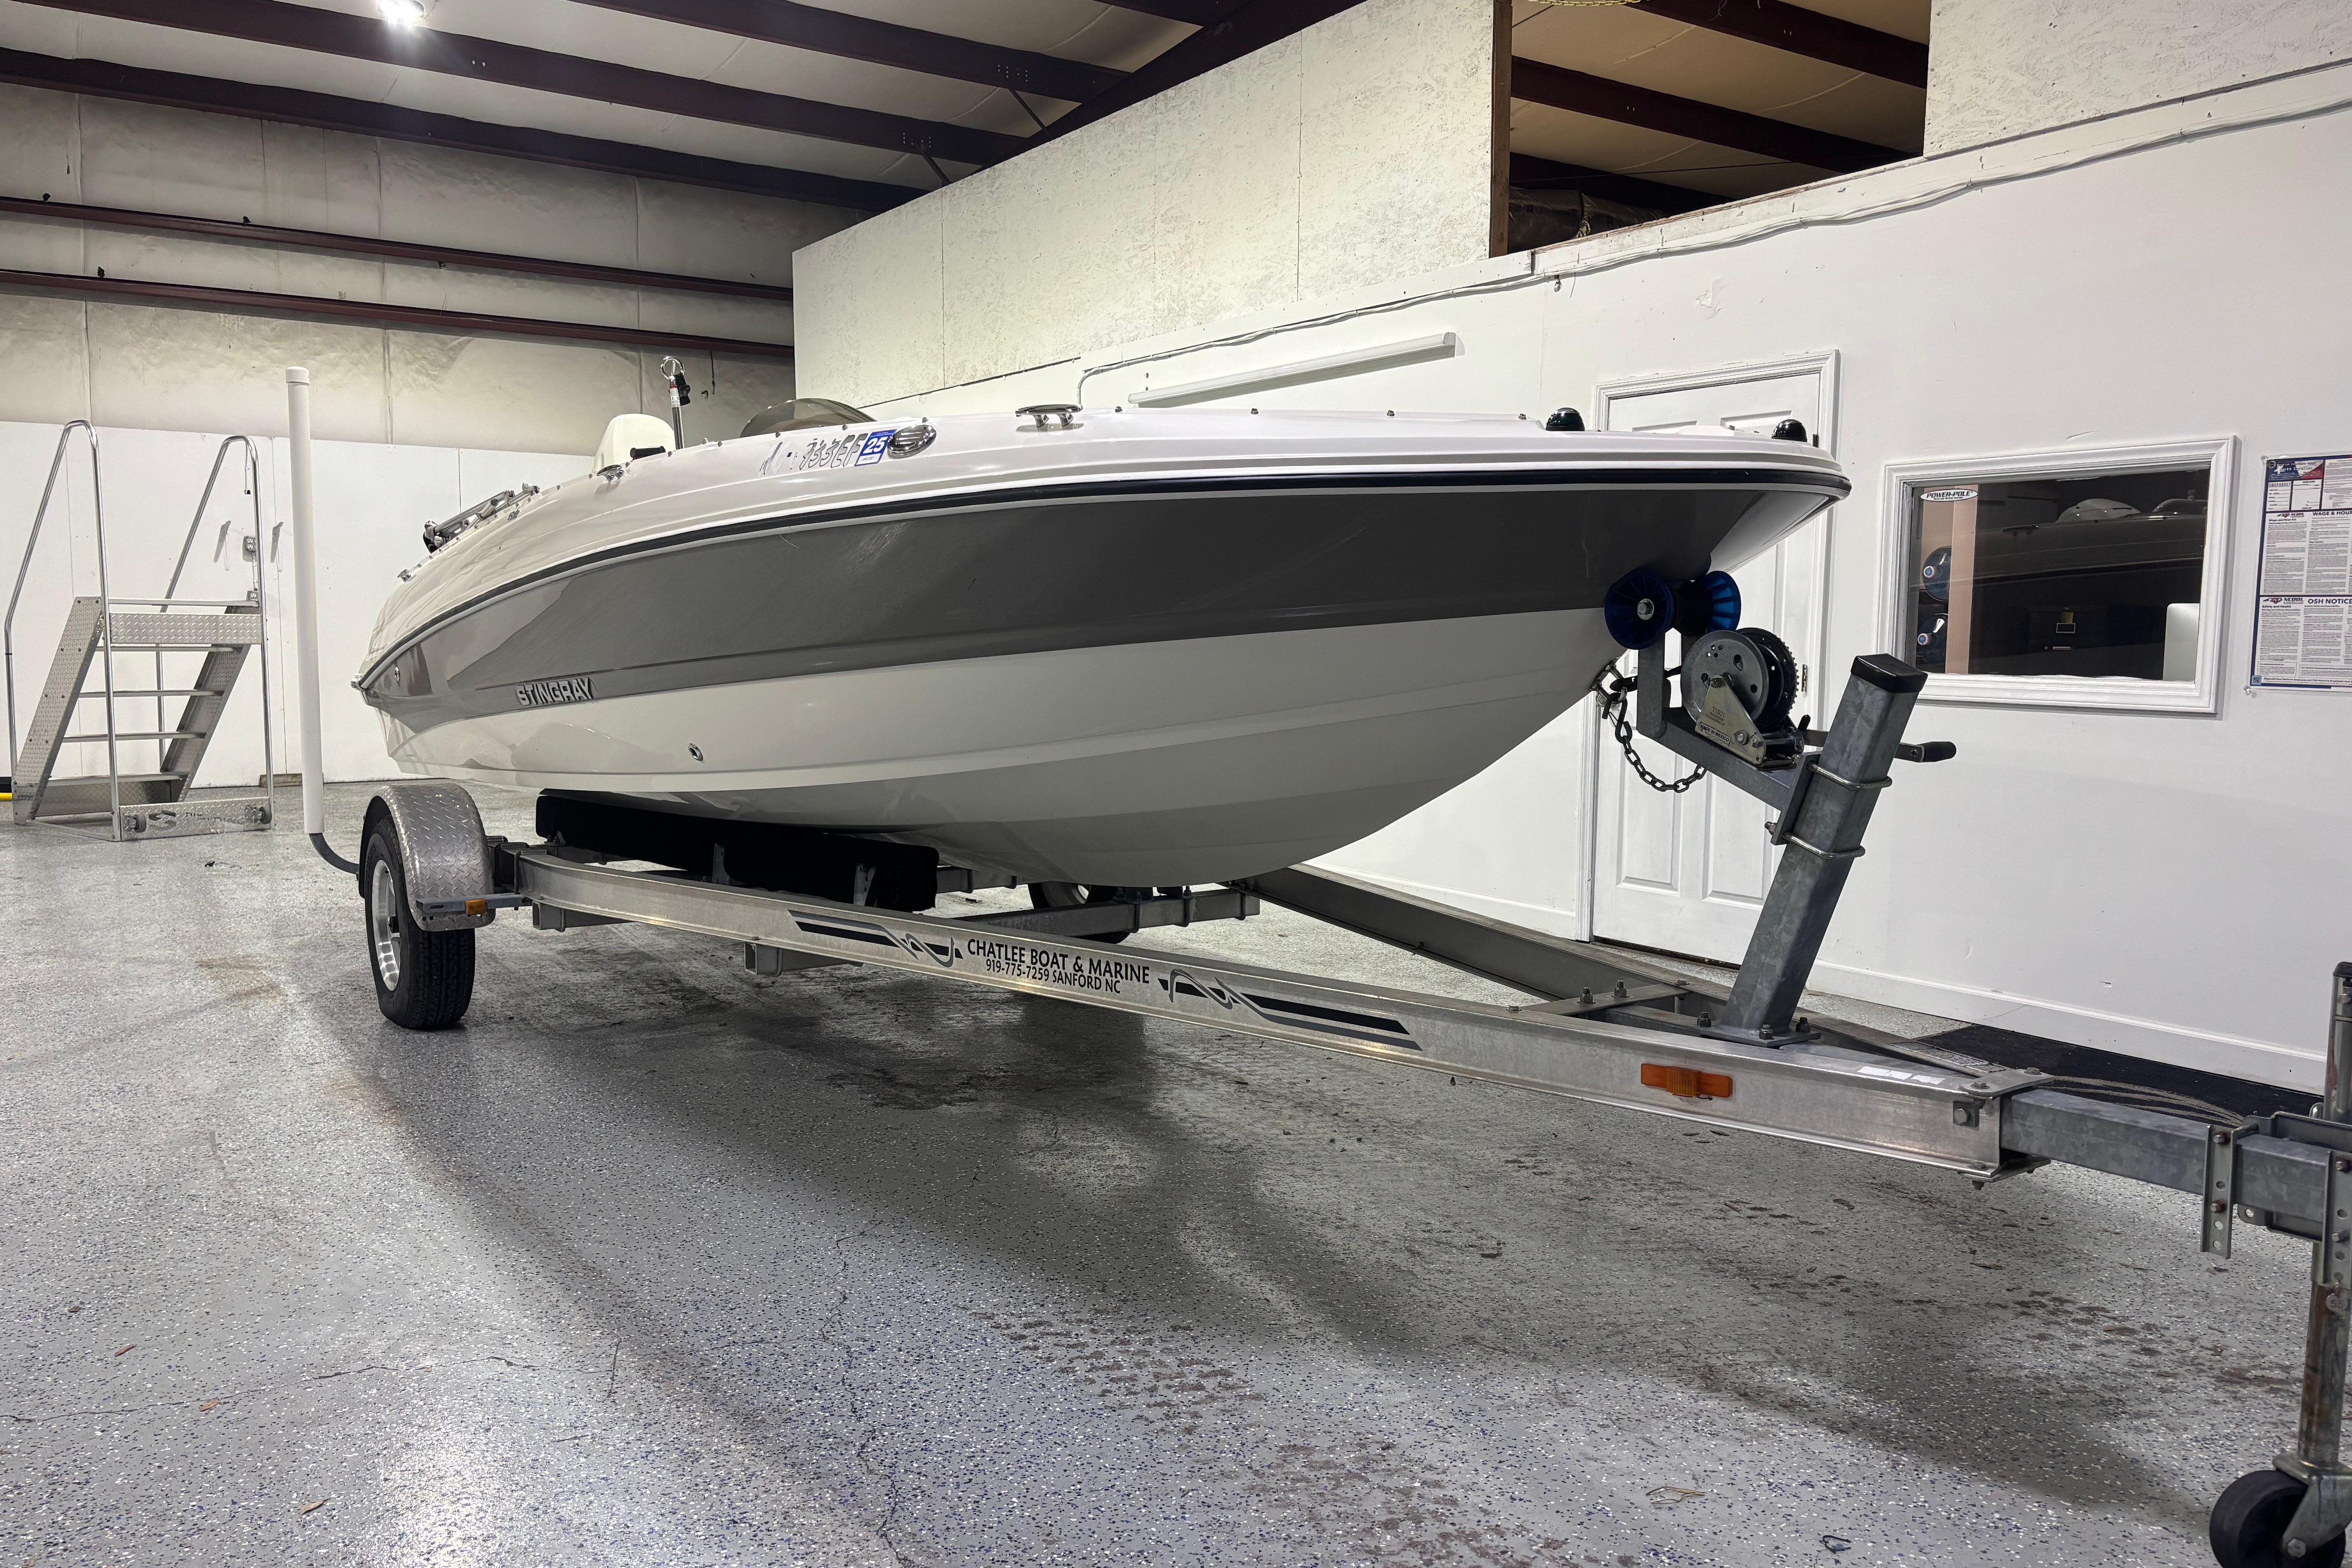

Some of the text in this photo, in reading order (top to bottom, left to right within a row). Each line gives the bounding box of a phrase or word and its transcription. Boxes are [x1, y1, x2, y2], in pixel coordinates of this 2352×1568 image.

[863, 436, 888, 454] 25
[516, 677, 593, 705] STINGRAY
[1715, 732, 1729, 742] MEXICO
[967, 938, 1150, 984] CHATLEE BOAT & MARINE
[986, 958, 1121, 994] 919-775-7259 SANFORD NC
